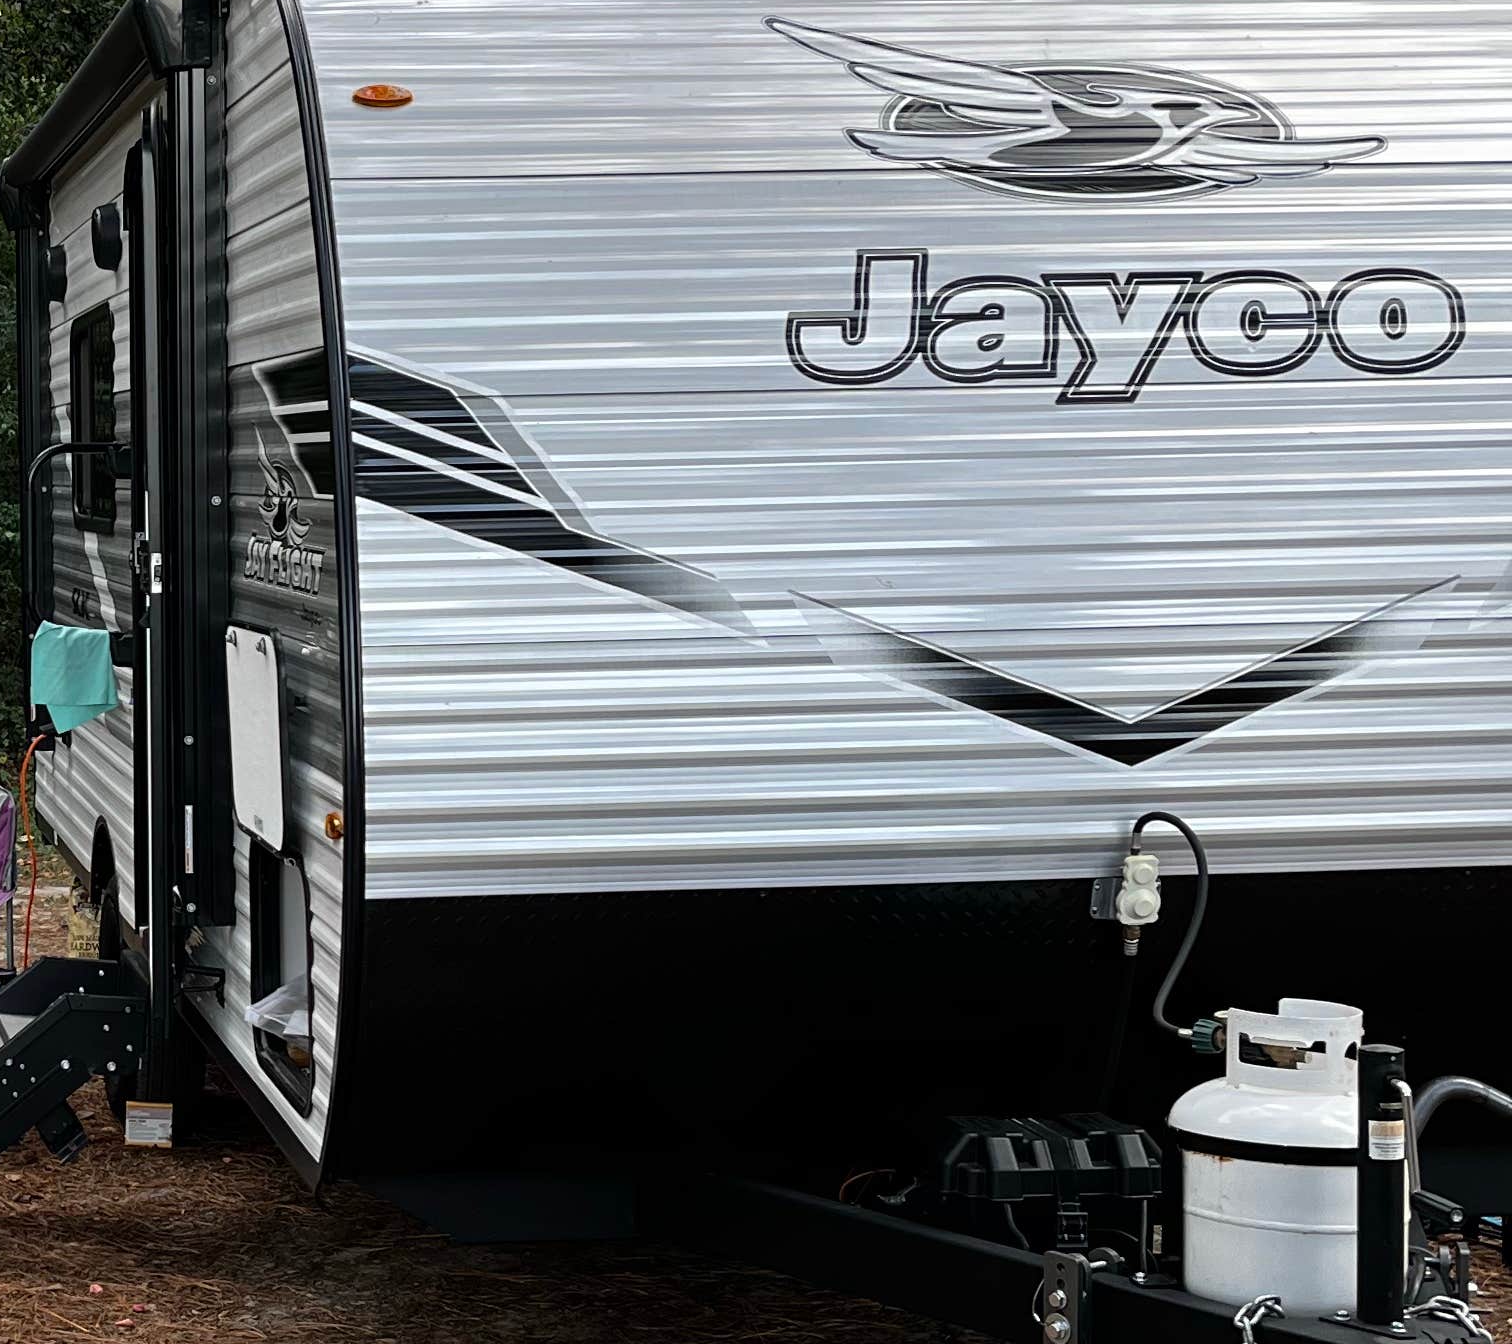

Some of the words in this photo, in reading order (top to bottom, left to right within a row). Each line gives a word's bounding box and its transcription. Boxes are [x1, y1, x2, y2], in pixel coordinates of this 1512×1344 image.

[787, 248, 1466, 405] Jayco
[243, 533, 270, 582] JAY
[268, 539, 326, 597] FLIGHT
